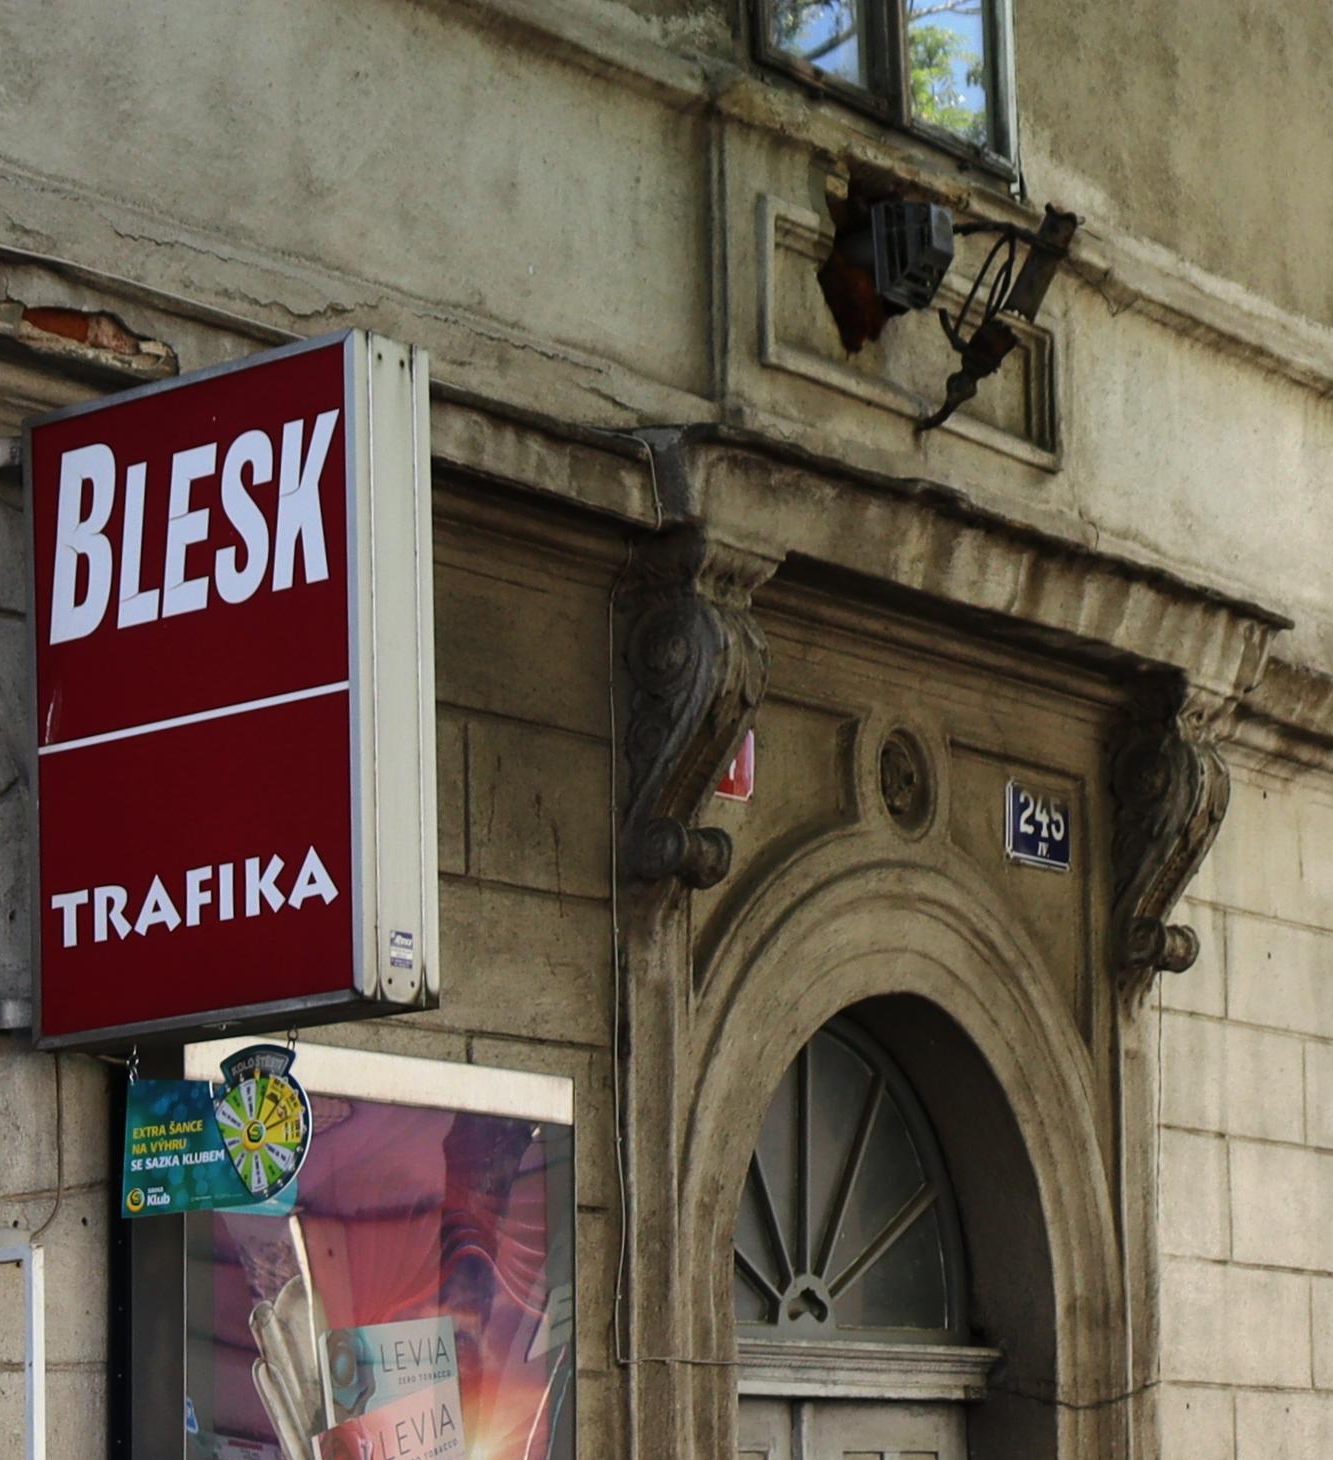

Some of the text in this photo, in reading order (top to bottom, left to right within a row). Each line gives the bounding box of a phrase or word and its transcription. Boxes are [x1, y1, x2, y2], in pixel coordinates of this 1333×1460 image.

[49, 408, 339, 646] BLESK
[1018, 794, 1065, 842] 245
[1037, 840, 1050, 858] IV.
[51, 845, 338, 948] TRAFIKA
[132, 1119, 203, 1140] EXTRA ŠANCE
[132, 1138, 186, 1155] NA VÝHRU
[131, 1149, 225, 1171] SE SAZKA KLUBEM
[146, 1191, 171, 1206] Klub
[380, 1334, 451, 1374] LEVIA
[398, 1375, 417, 1386] ZERO
